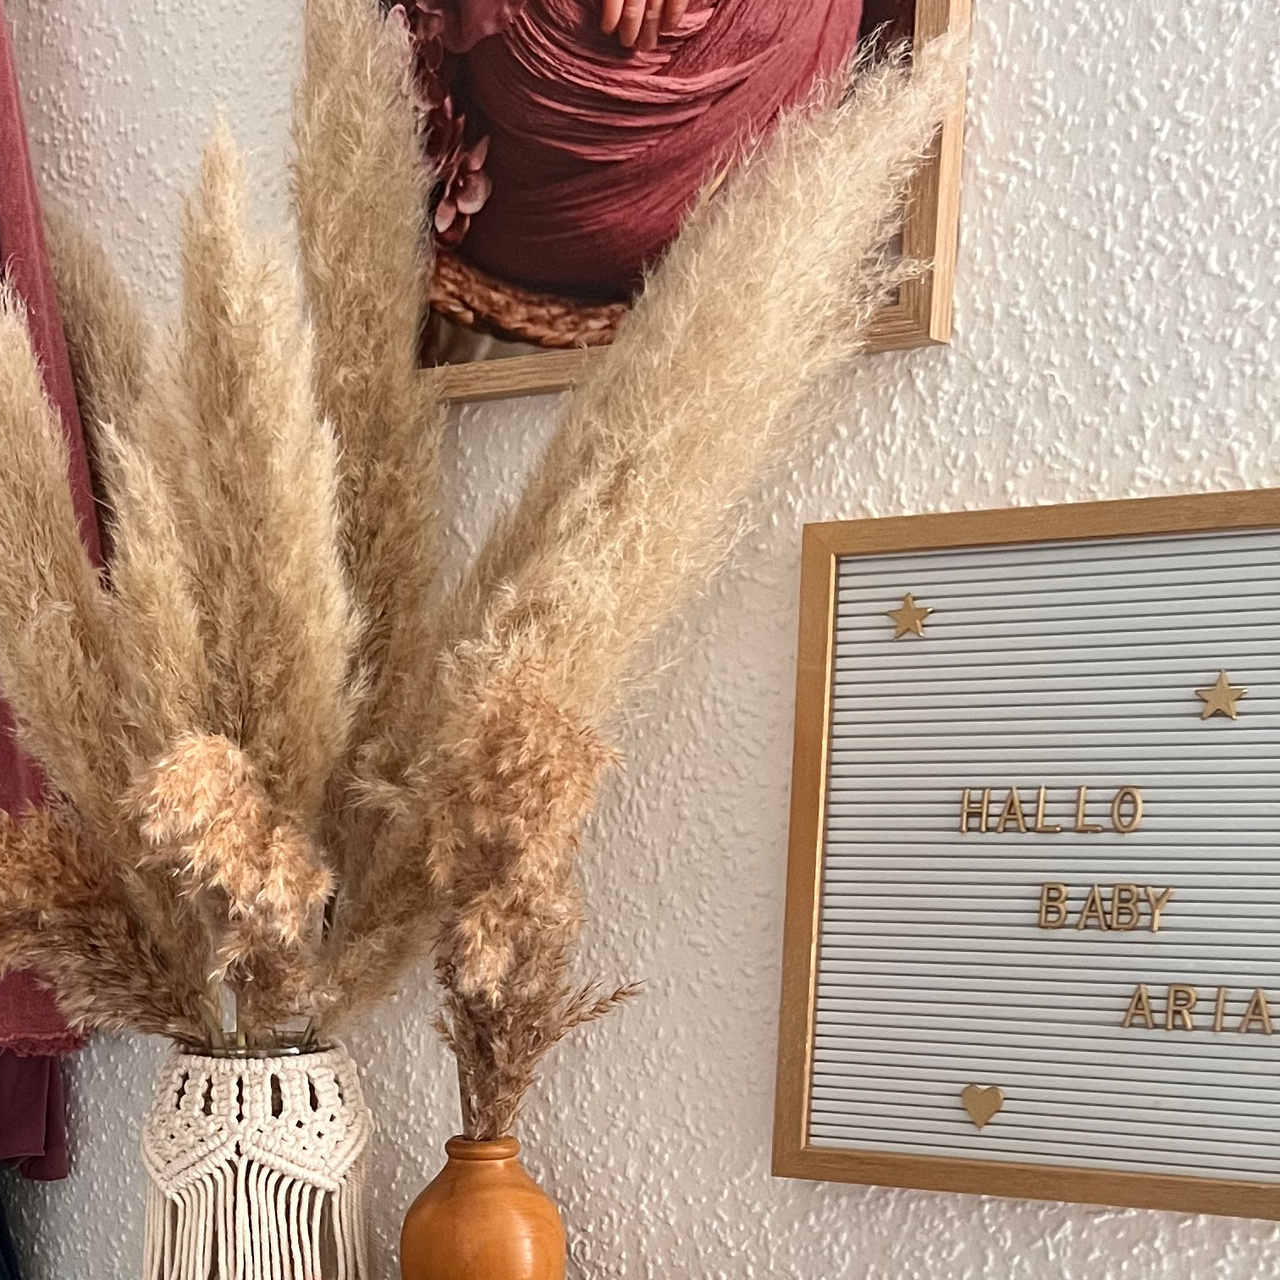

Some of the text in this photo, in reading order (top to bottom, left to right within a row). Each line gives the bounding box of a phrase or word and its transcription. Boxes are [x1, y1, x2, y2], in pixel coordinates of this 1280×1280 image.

[960, 784, 1143, 833] HALLO
[1038, 882, 1173, 932] BABY
[1122, 983, 1273, 1034] ARIA
